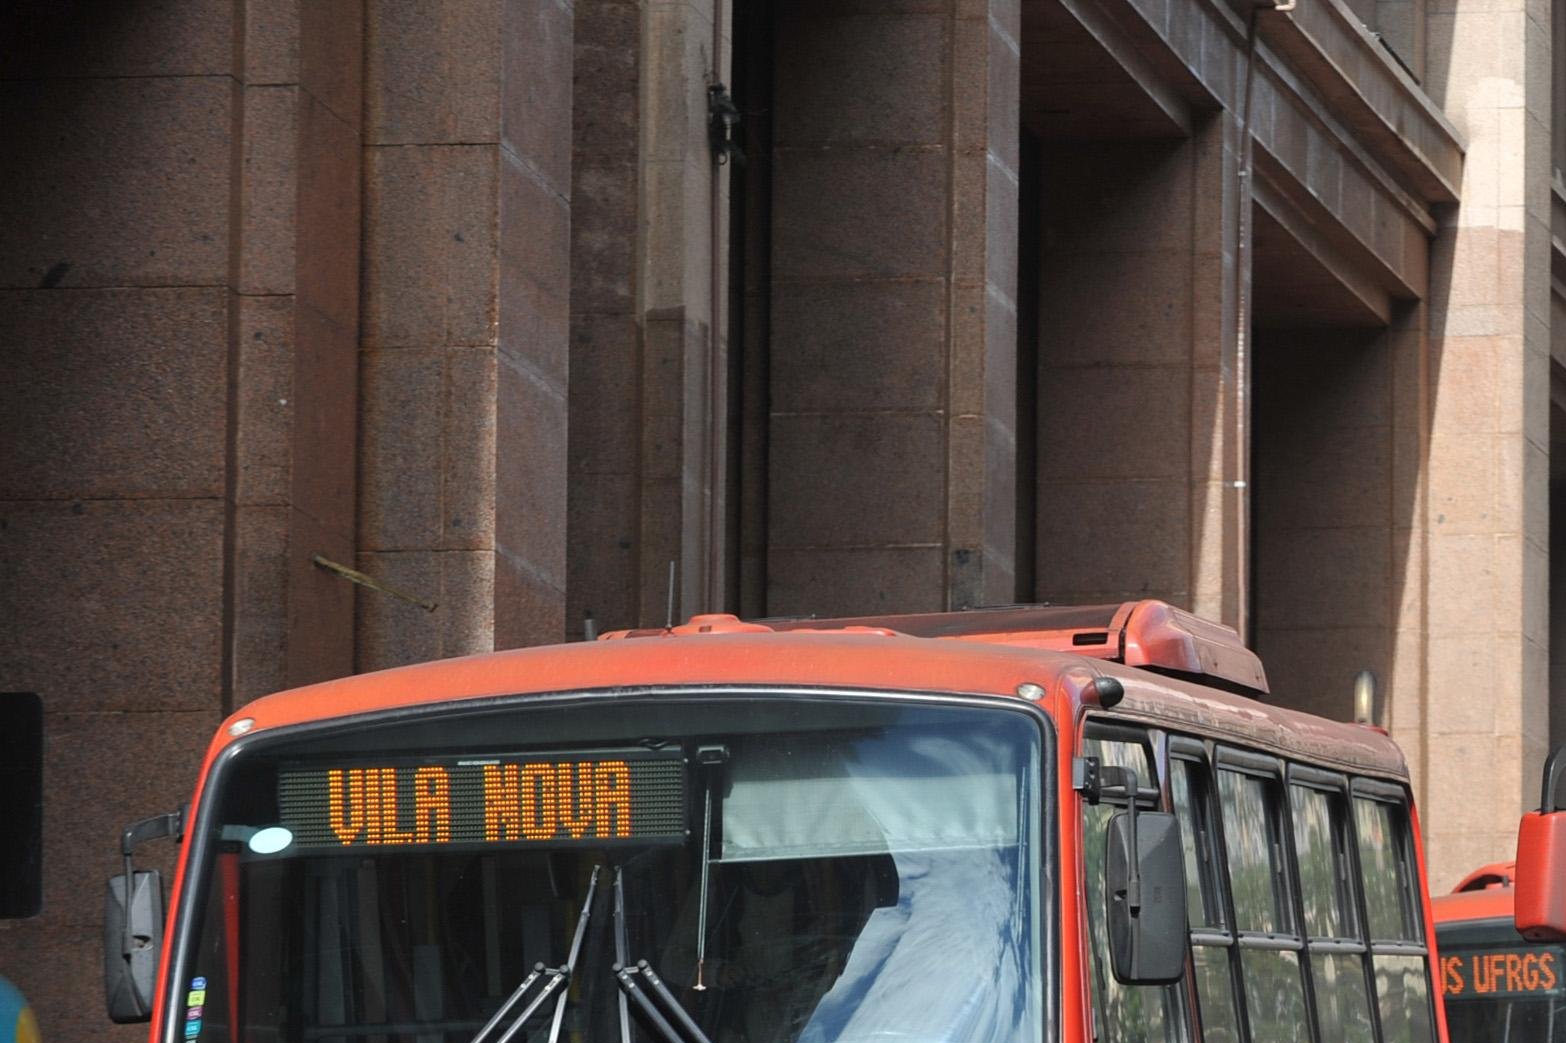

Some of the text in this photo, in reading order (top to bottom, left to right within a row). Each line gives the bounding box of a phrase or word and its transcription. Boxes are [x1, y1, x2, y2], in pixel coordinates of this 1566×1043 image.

[328, 761, 630, 846] VILA NOVA
[1472, 952, 1556, 992] UFRGS
